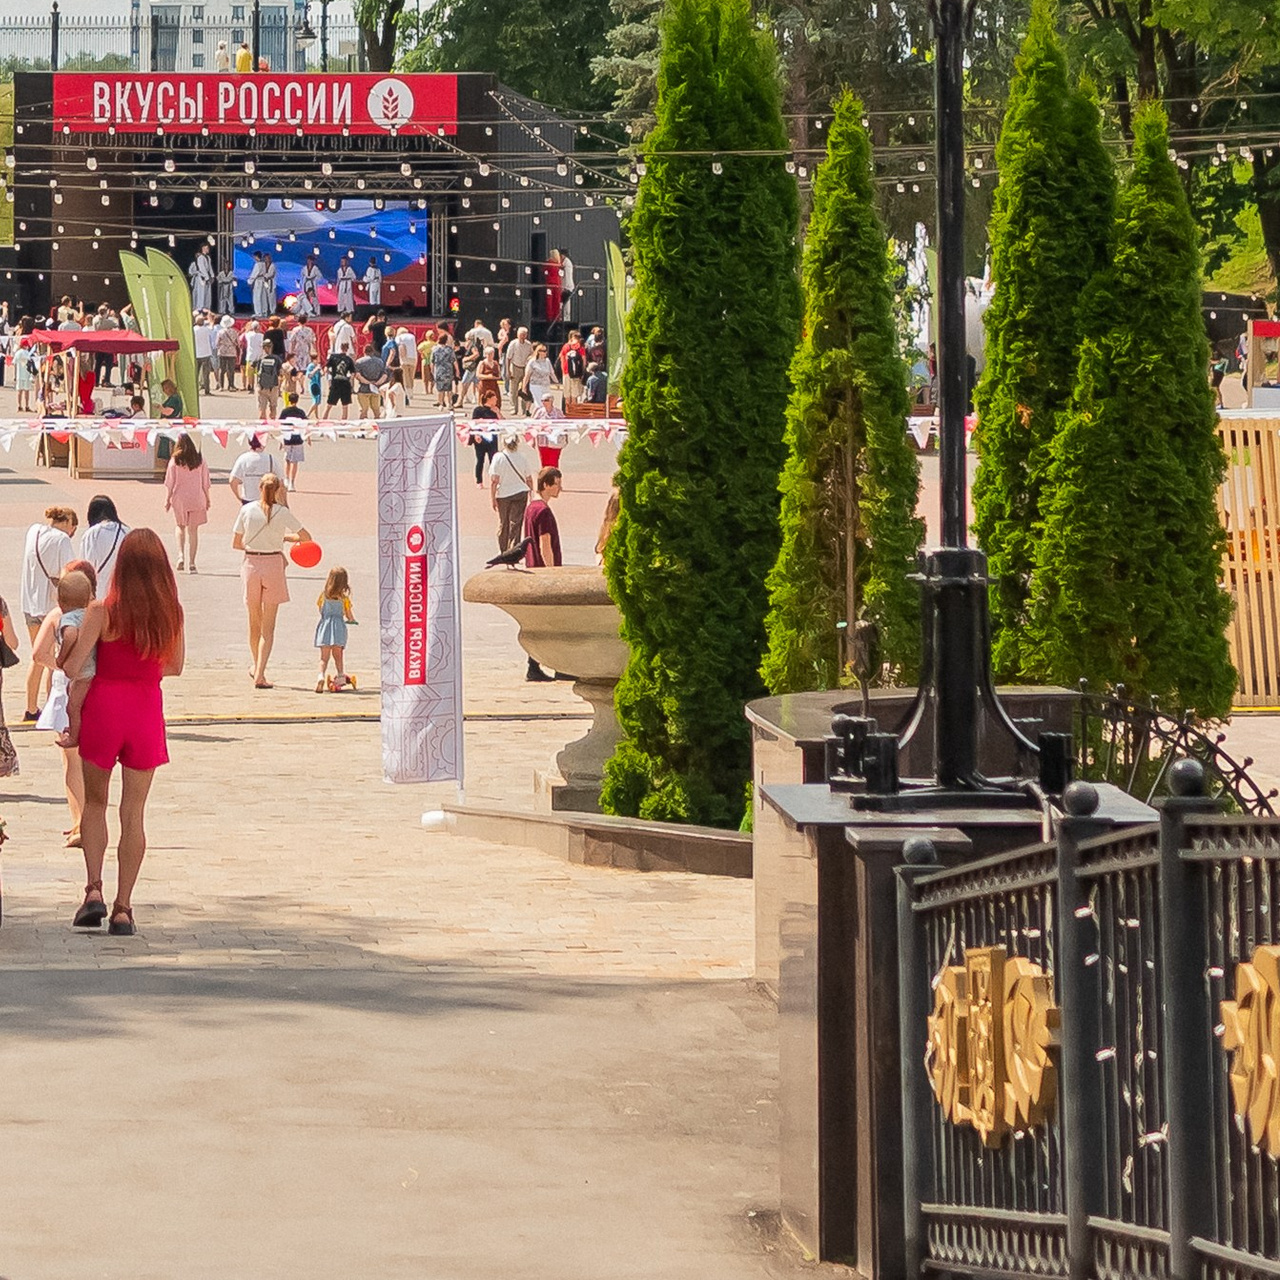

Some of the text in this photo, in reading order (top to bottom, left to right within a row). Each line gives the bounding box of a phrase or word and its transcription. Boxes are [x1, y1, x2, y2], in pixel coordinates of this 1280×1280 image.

[92, 81, 352, 125] ВКУСЫ РОССИИ
[409, 562, 423, 679] ВКУСЫ РОССИИ
